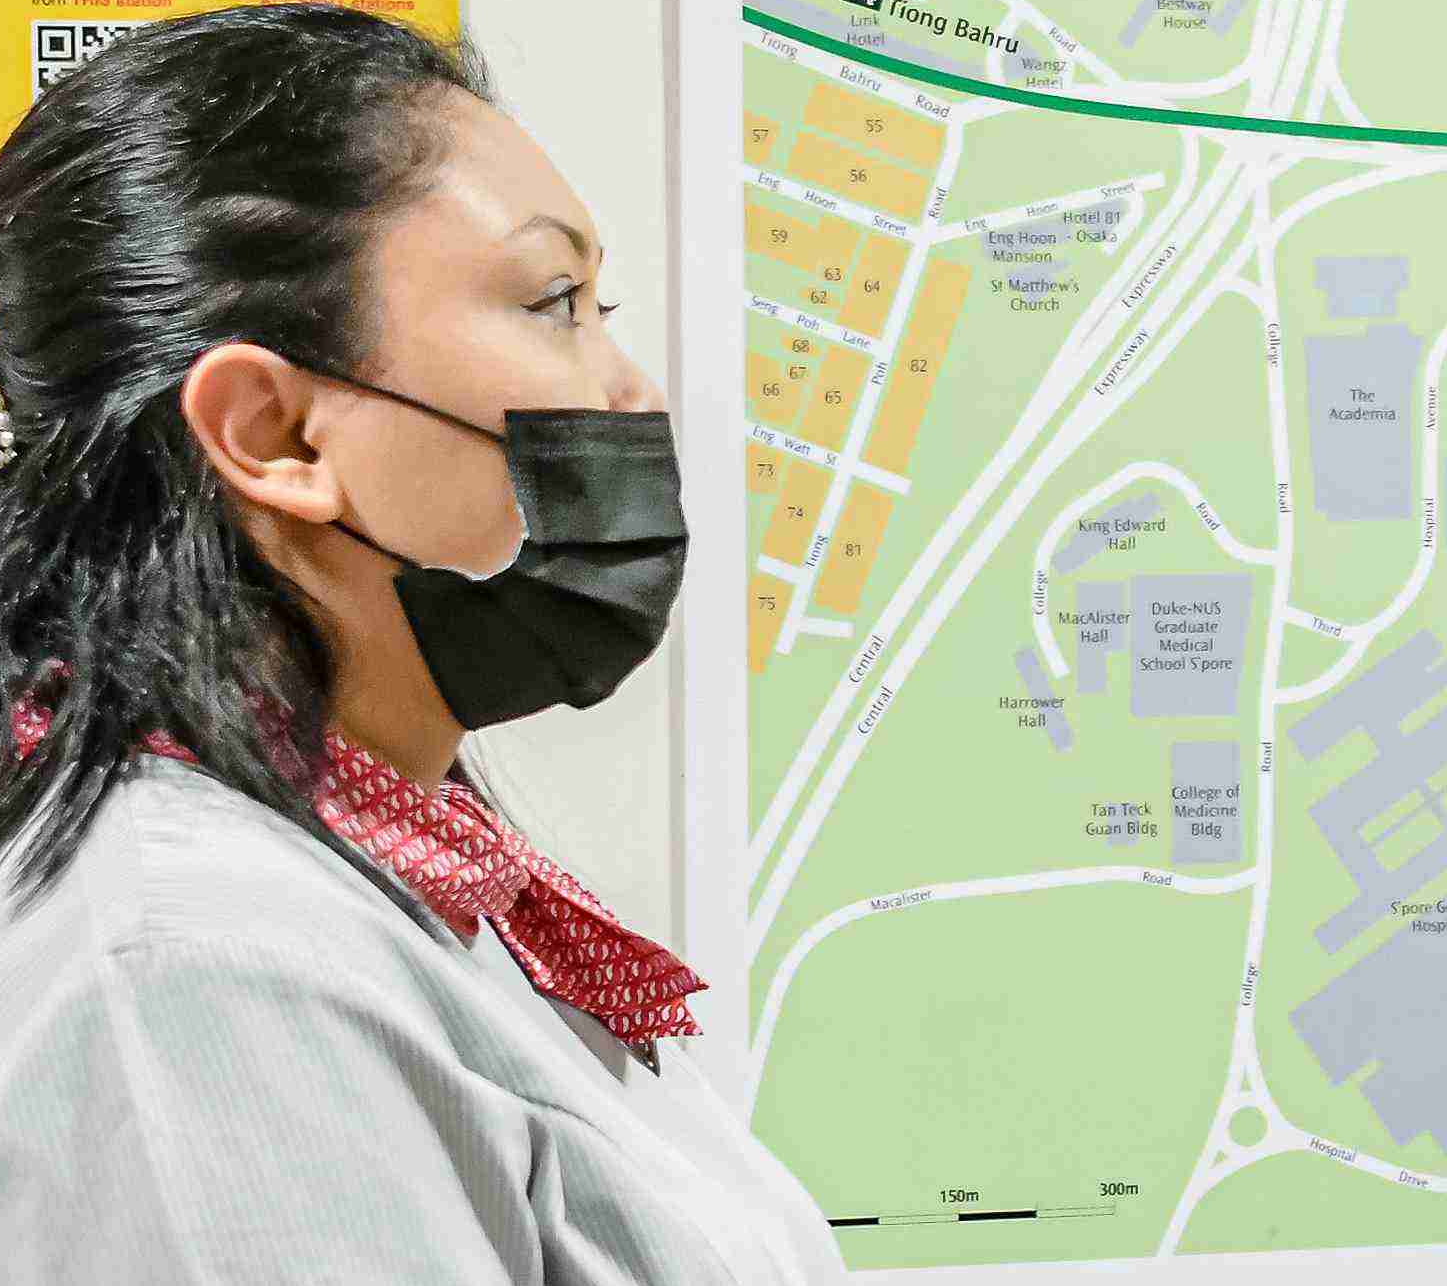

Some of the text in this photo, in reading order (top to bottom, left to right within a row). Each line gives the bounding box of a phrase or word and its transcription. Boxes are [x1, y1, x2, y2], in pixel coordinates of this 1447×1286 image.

[1164, 16, 1207, 29] House
[954, 20, 1020, 55] Bahru
[866, 120, 884, 132] 55
[752, 130, 769, 142] 57
[850, 170, 867, 183] 56
[989, 231, 1057, 247] Eng Hoon
[993, 250, 1052, 264] Mansion
[991, 279, 1080, 294] St Matthew's
[1011, 297, 1060, 311] Church
[911, 359, 928, 373] 82
[1350, 389, 1375, 403] The
[1329, 407, 1397, 421] Academia
[1079, 518, 1166, 535] King Edward
[1109, 536, 1137, 551] Hall
[1152, 602, 1222, 616] Duke-NUS
[1155, 620, 1219, 634] Graduate
[1159, 638, 1214, 653] Medical
[1140, 657, 1186, 671] School
[999, 696, 1065, 710] Harrower
[1019, 714, 1046, 727] Hall
[1091, 802, 1152, 816] Tan Teck
[1086, 821, 1158, 838] Guan Bldg
[939, 1188, 980, 1204] 150m
[1099, 1181, 1139, 1198] 300m
